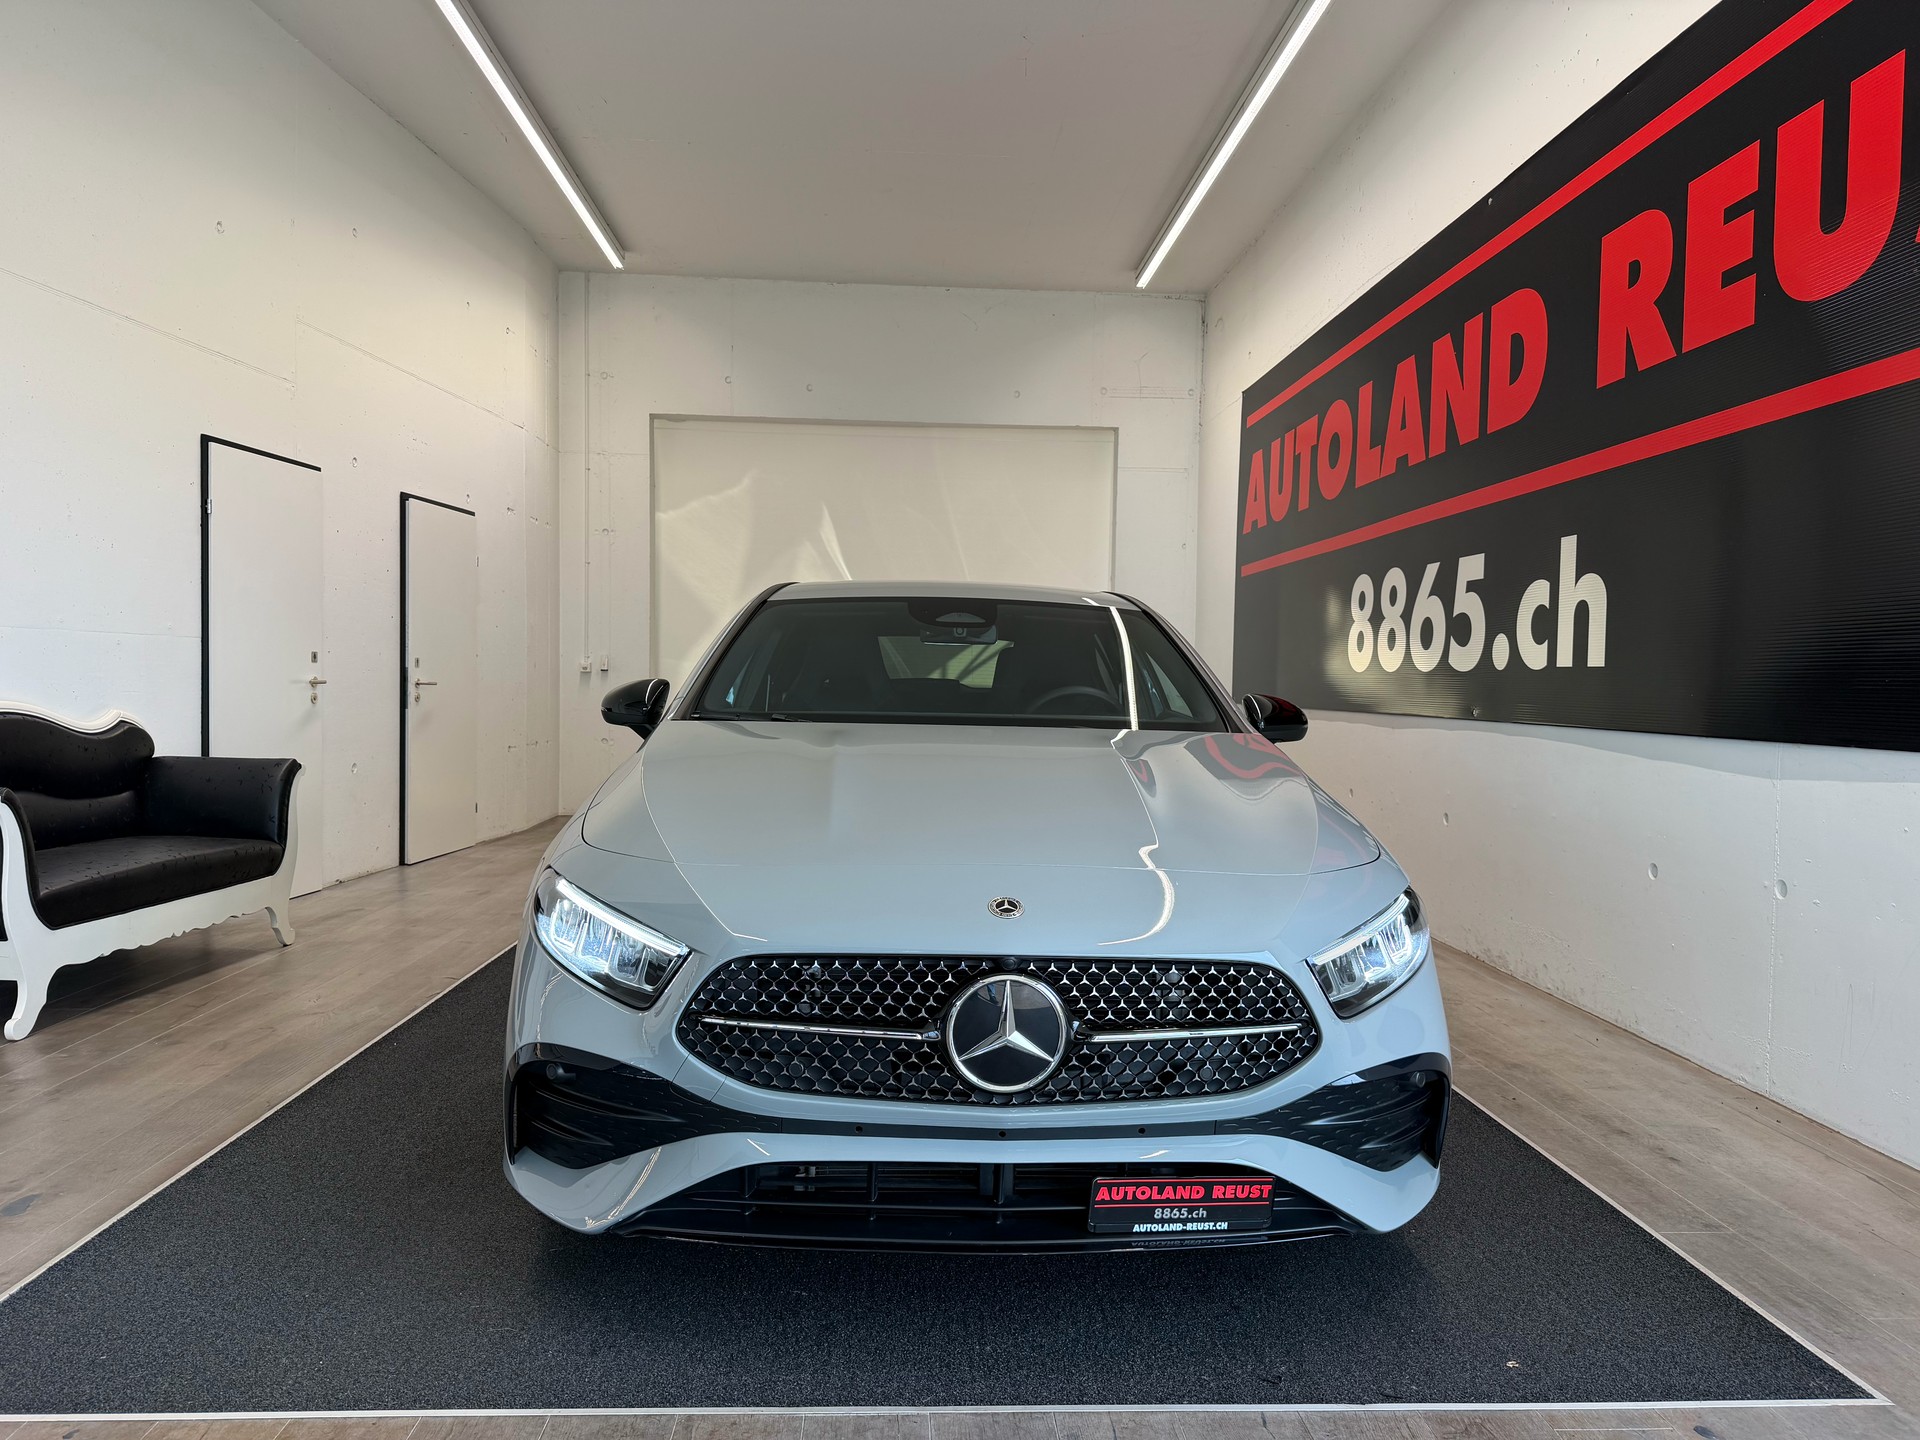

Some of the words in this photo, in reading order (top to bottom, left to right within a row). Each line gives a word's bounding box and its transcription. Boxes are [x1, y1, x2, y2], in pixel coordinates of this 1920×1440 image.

[1242, 288, 1549, 534] AUTOLAND
[1596, 48, 1920, 389] REU
[1347, 534, 1608, 673] 8865.ch
[1095, 1186, 1205, 1201] AUTOLAND
[1212, 1185, 1272, 1199] REUST
[1153, 1208, 1207, 1219] 8865.ch
[1132, 1222, 1228, 1232] AUTOLAND-REUST.CH
